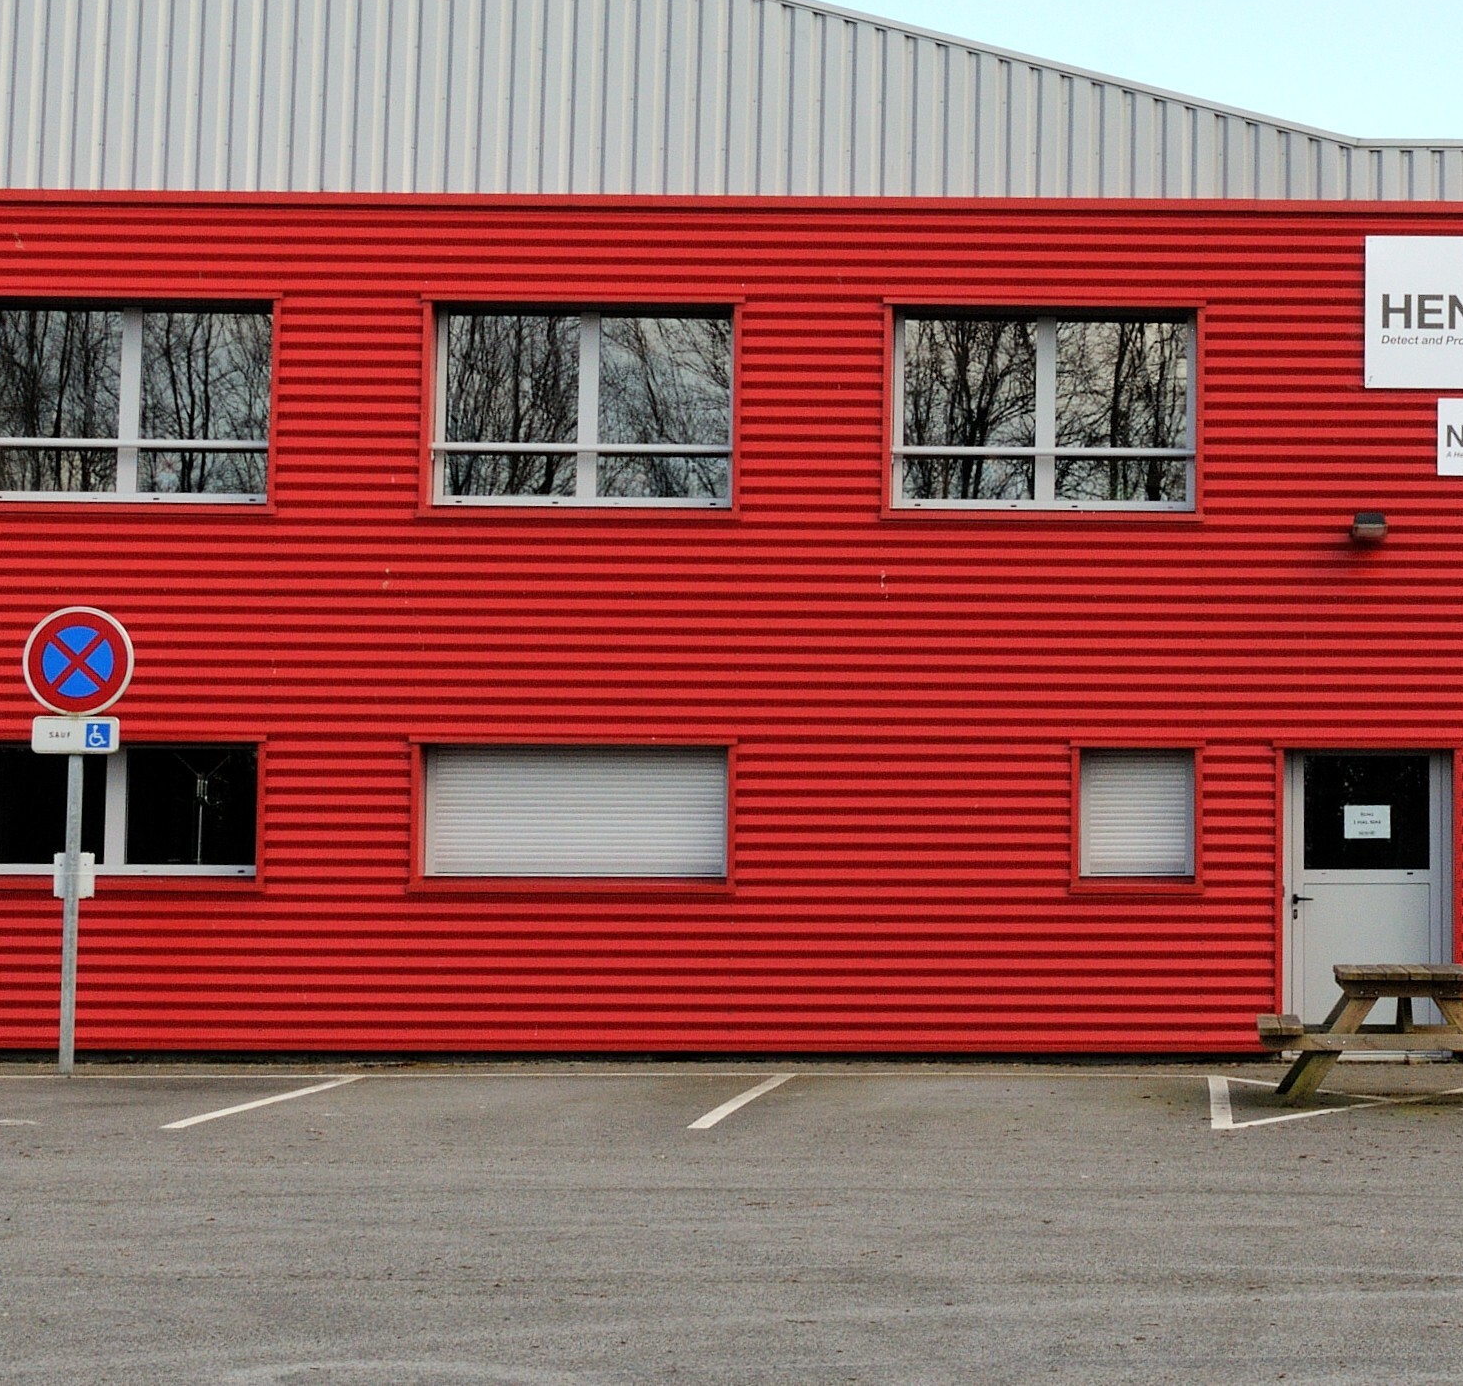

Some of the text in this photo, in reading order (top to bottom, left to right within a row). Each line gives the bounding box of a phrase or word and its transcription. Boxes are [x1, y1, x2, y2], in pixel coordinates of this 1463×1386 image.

[1381, 335, 1419, 345] Detect
[1422, 335, 1444, 345] and
[1446, 451, 1452, 459] A
[49, 731, 71, 739] SAUF
